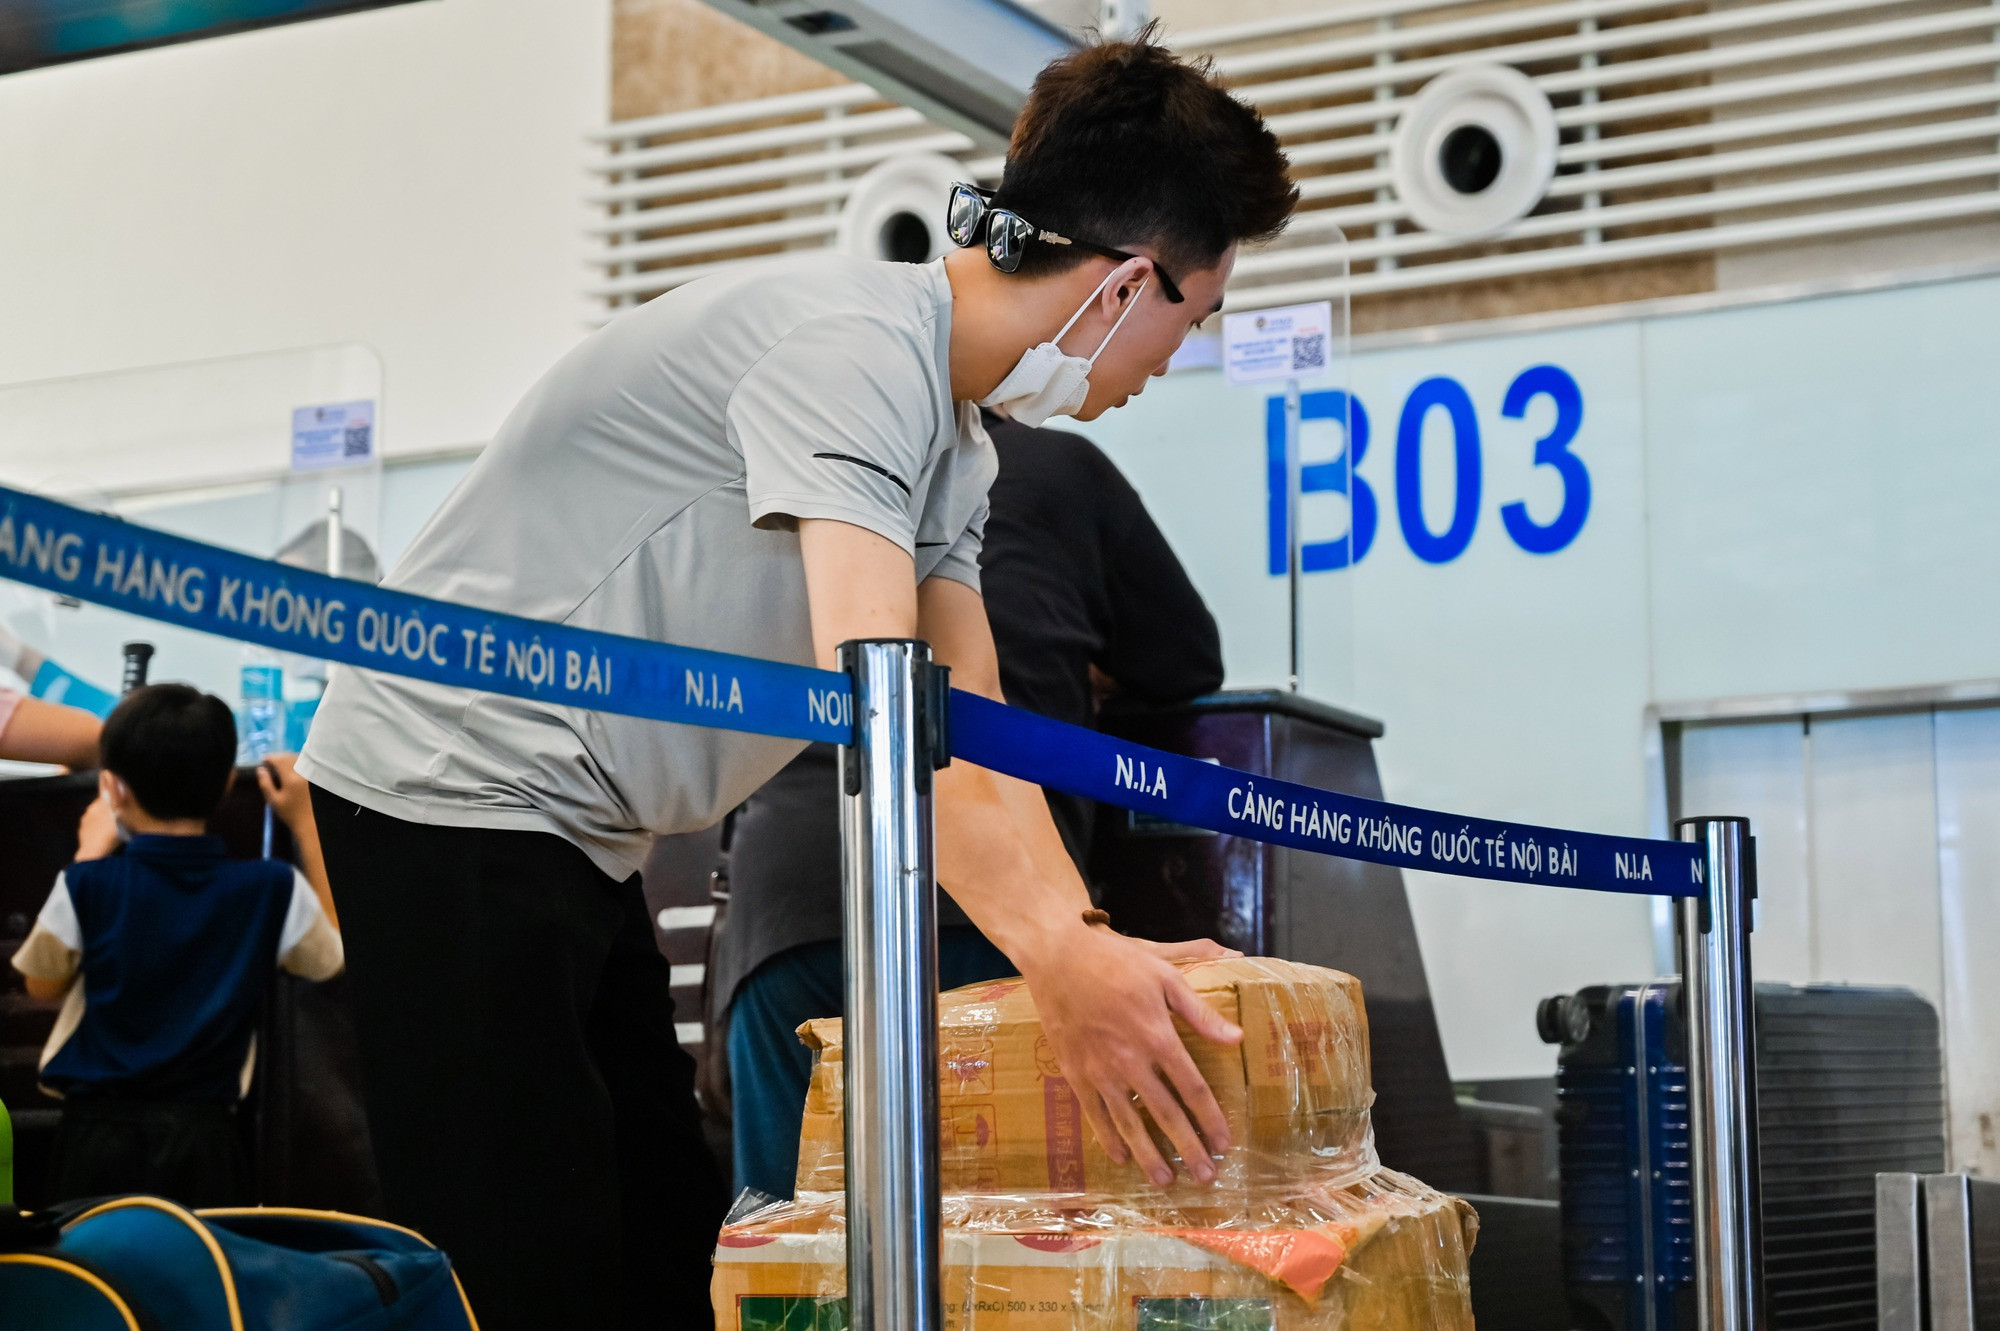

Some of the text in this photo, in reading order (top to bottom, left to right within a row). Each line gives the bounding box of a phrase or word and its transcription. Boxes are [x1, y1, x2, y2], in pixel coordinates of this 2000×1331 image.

[1265, 362, 1592, 577] B03
[505, 635, 555, 692] NỘI
[565, 646, 612, 695] BÀI
[685, 669, 744, 714] N.I.A
[1115, 754, 1168, 800] N.I.A
[1228, 781, 1578, 878] CẢNG HÀNG KHÔNG QUỐC TẾ NỘI BÀI
[1615, 852, 1653, 881] N.I.A
[1007, 1301, 1026, 1312] 500
[1029, 1303, 1036, 1312] x
[1038, 1301, 1058, 1312] 330
[1061, 1304, 1067, 1312] x
